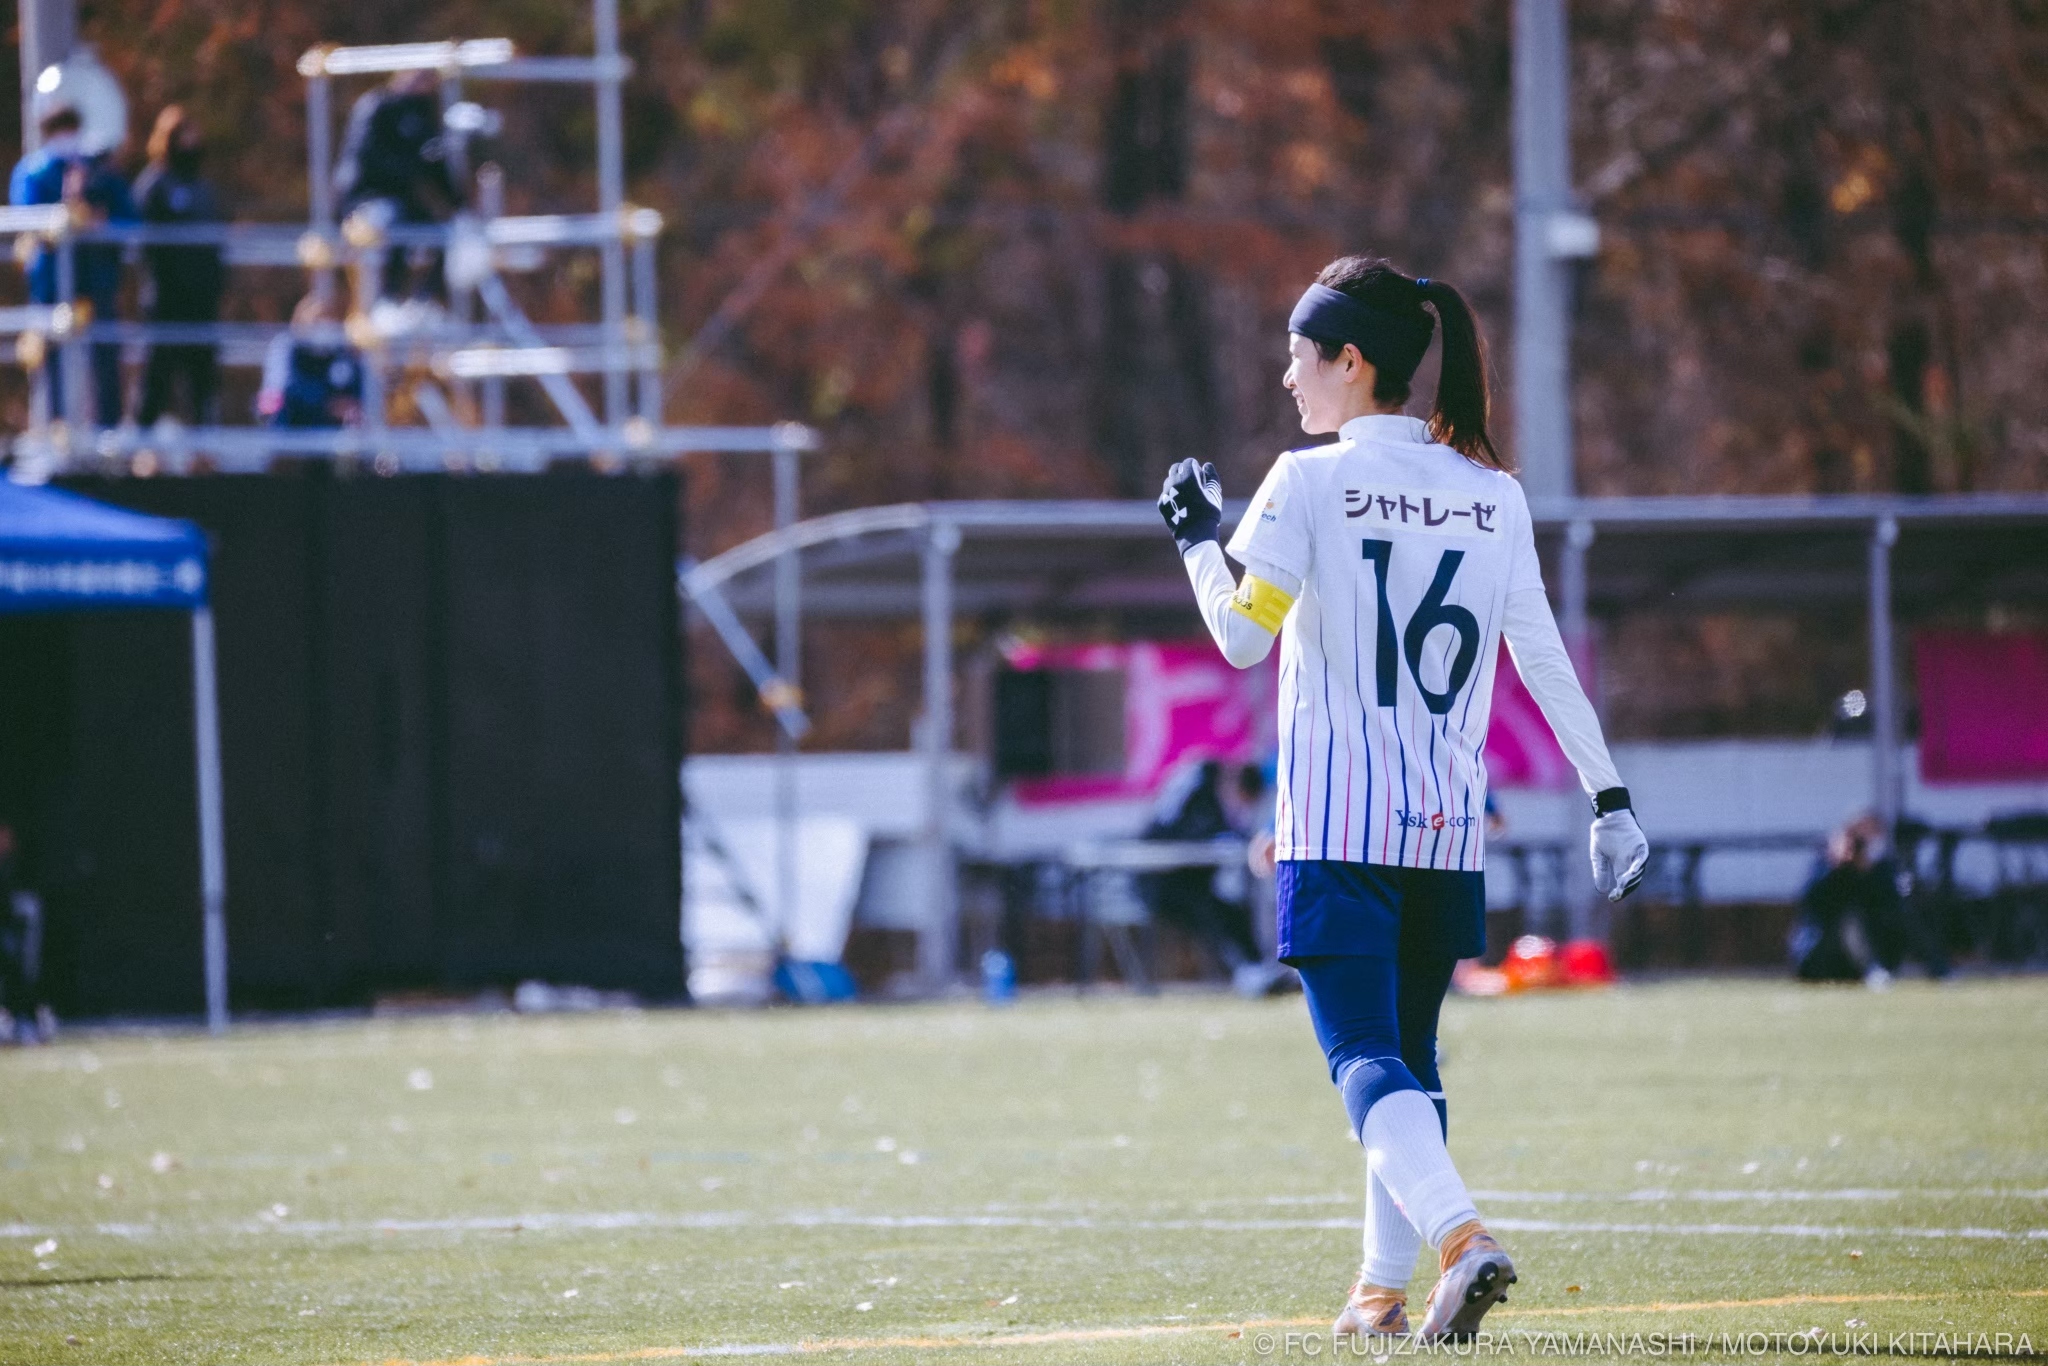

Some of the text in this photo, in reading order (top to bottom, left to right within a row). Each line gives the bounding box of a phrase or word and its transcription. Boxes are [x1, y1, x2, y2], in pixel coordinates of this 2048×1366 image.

[1345, 490, 1496, 532] シャトレーゼ
[1362, 539, 1480, 714] 16
